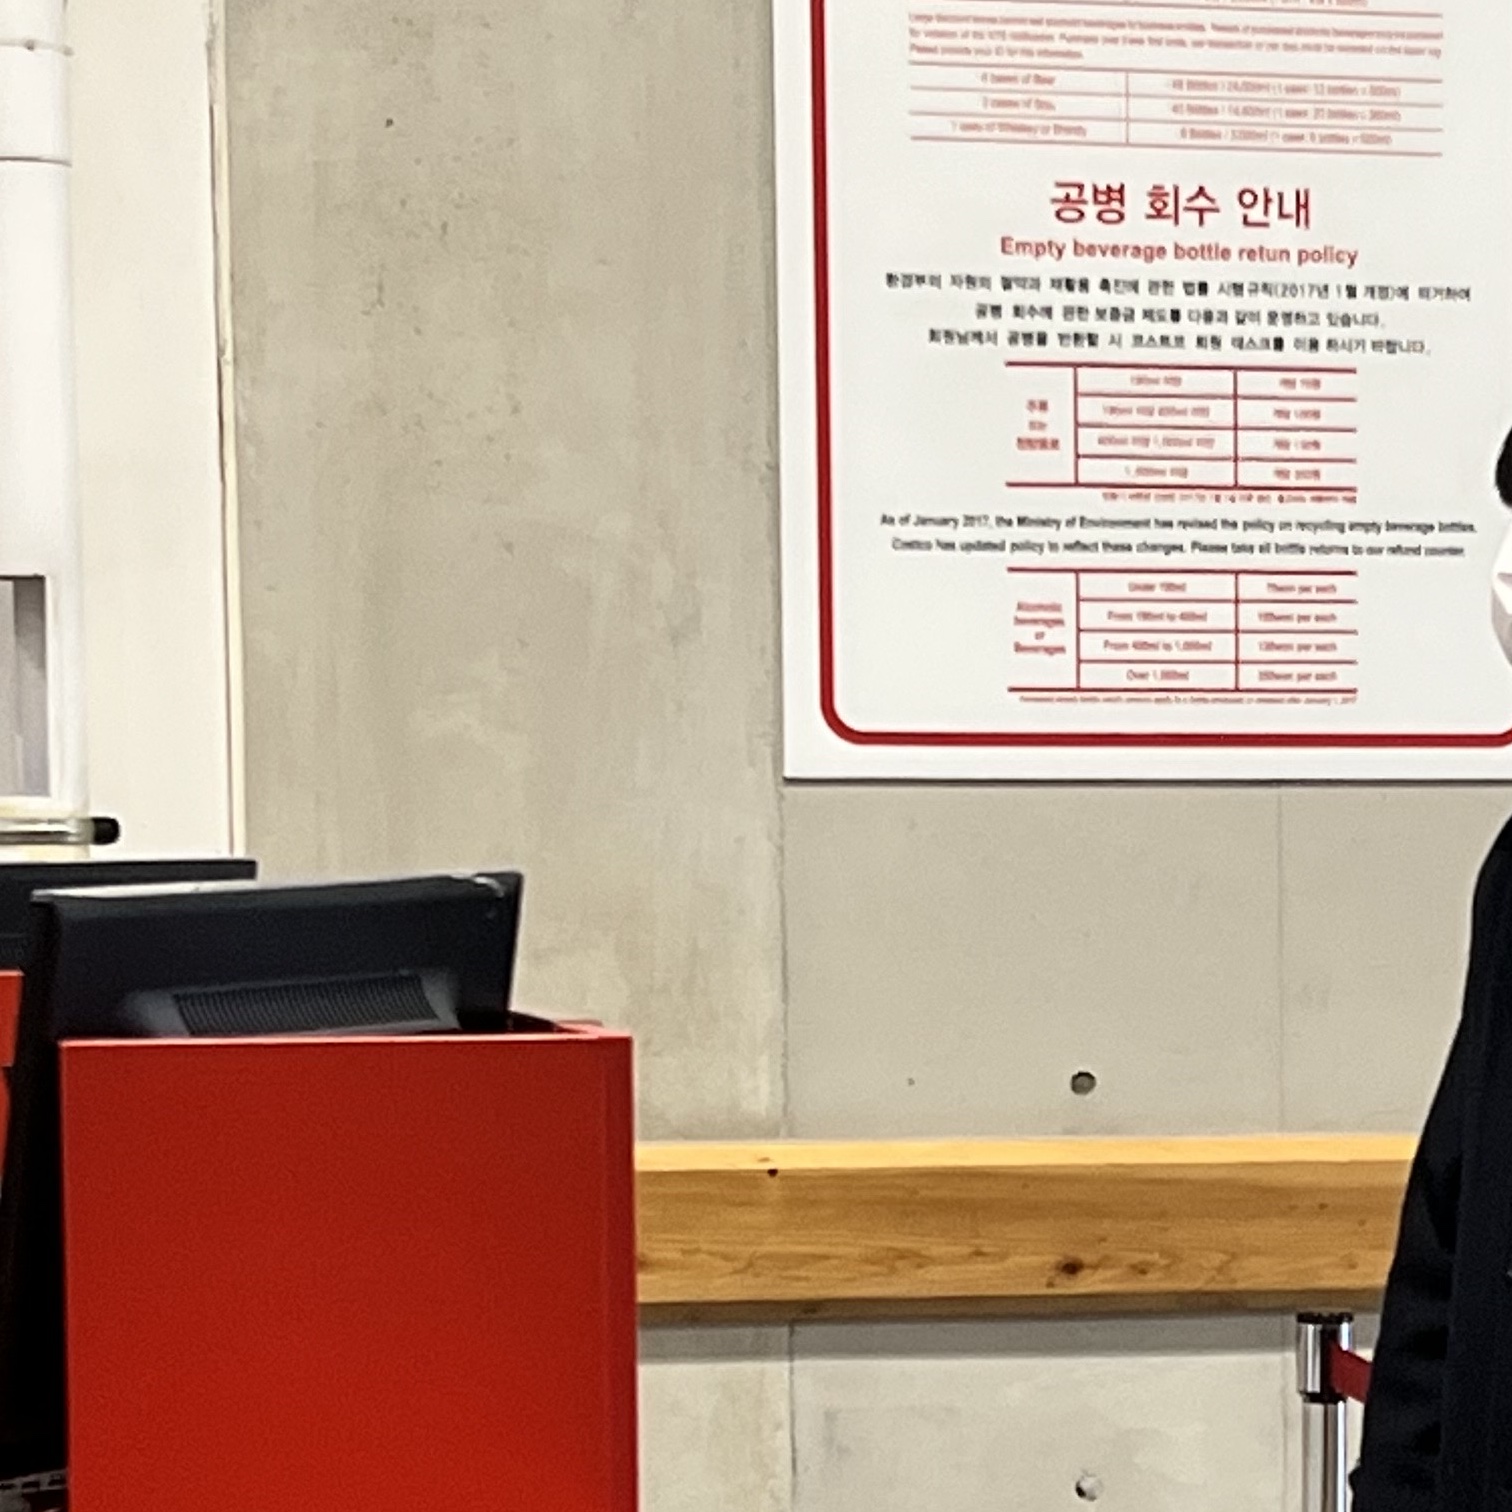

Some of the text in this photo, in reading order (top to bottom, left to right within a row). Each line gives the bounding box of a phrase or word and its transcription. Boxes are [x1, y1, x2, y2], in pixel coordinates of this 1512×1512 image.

[1050, 181, 1311, 230] 공병 회수 안내
[1000, 235, 1359, 270] Empty beverage bottle retun policy
